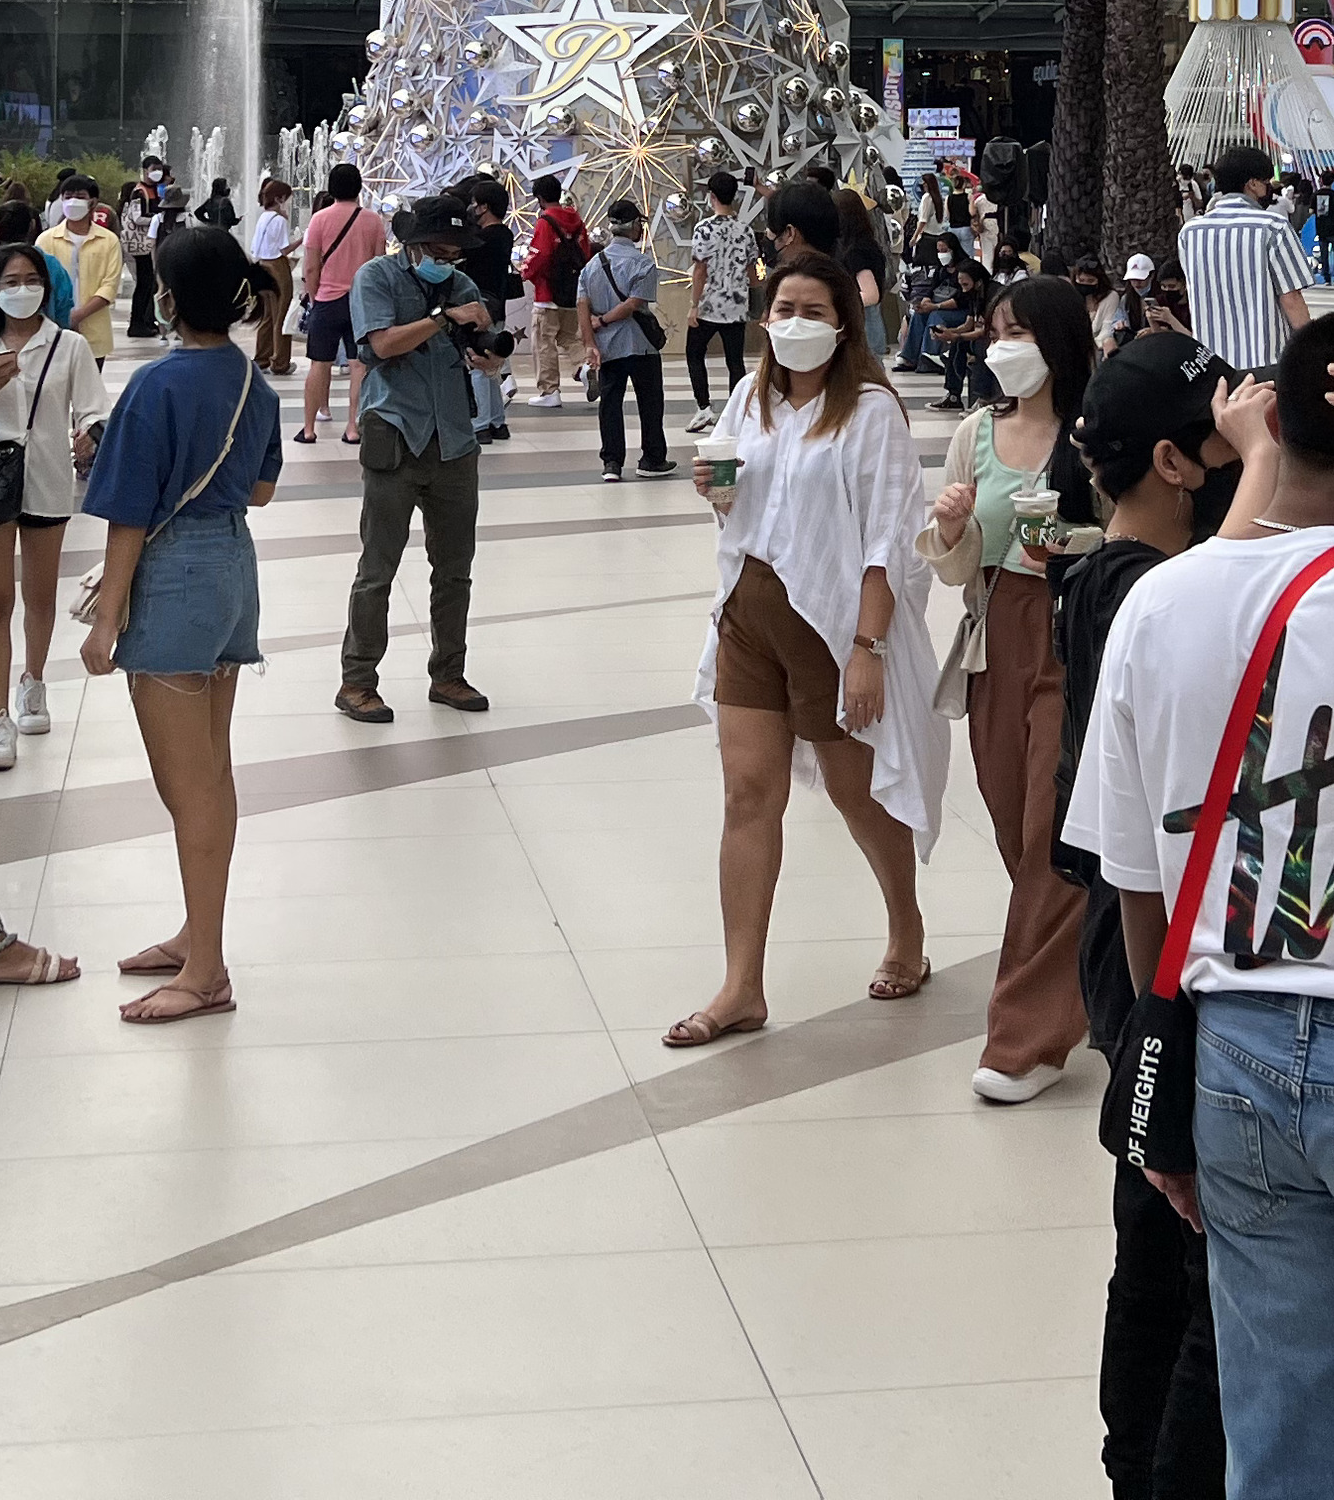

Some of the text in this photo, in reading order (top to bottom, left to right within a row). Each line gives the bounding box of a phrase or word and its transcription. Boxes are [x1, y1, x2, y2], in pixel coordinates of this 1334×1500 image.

[93, 211, 107, 223] R
[1127, 1036, 1163, 1168] OF HEIGHTS
